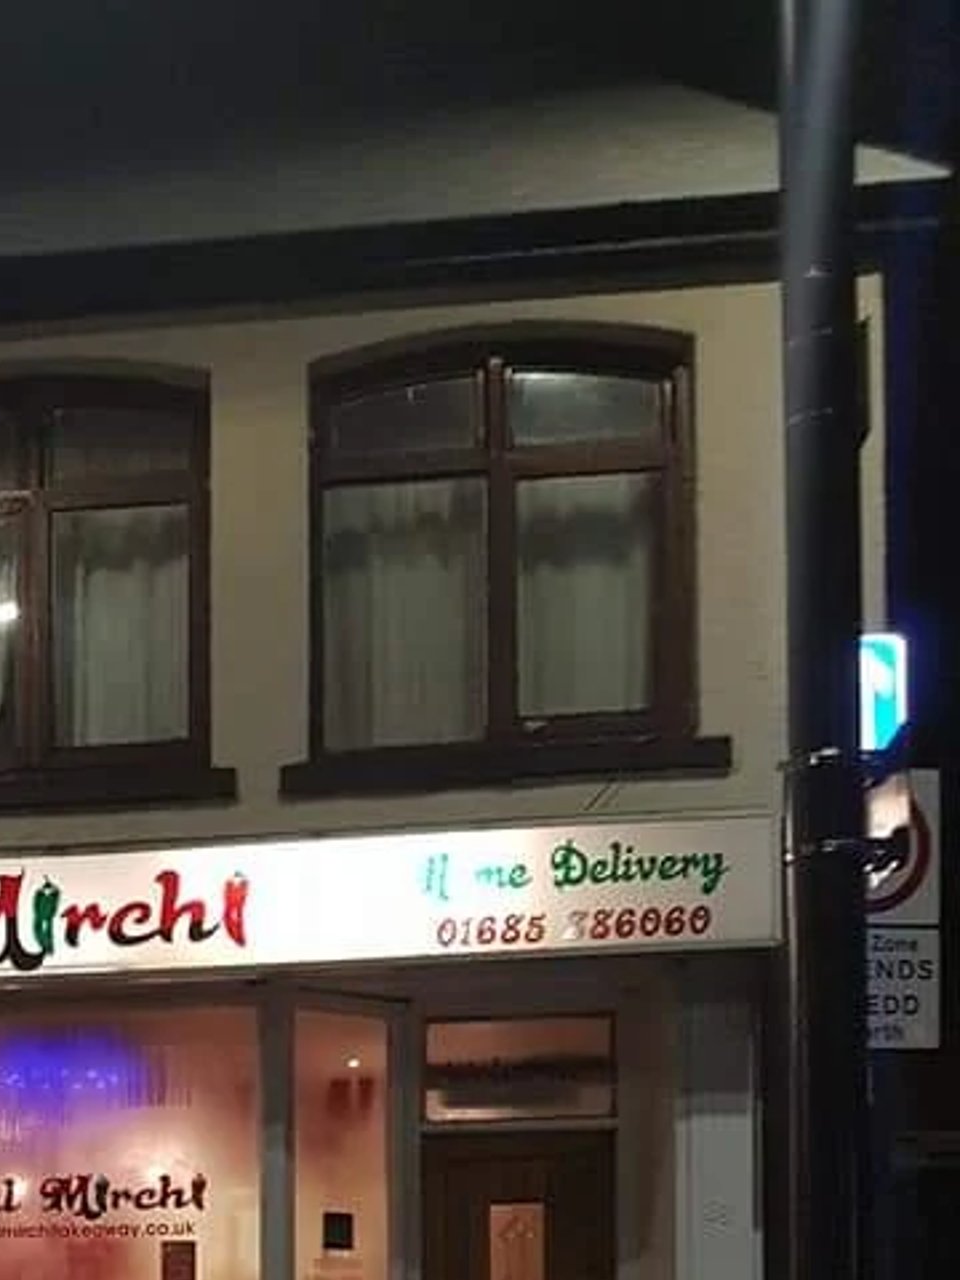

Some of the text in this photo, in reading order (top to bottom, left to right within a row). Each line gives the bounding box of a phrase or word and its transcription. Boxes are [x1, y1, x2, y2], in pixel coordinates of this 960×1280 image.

[423, 840, 730, 902] Hme Delivery
[437, 913, 547, 947] 01685
